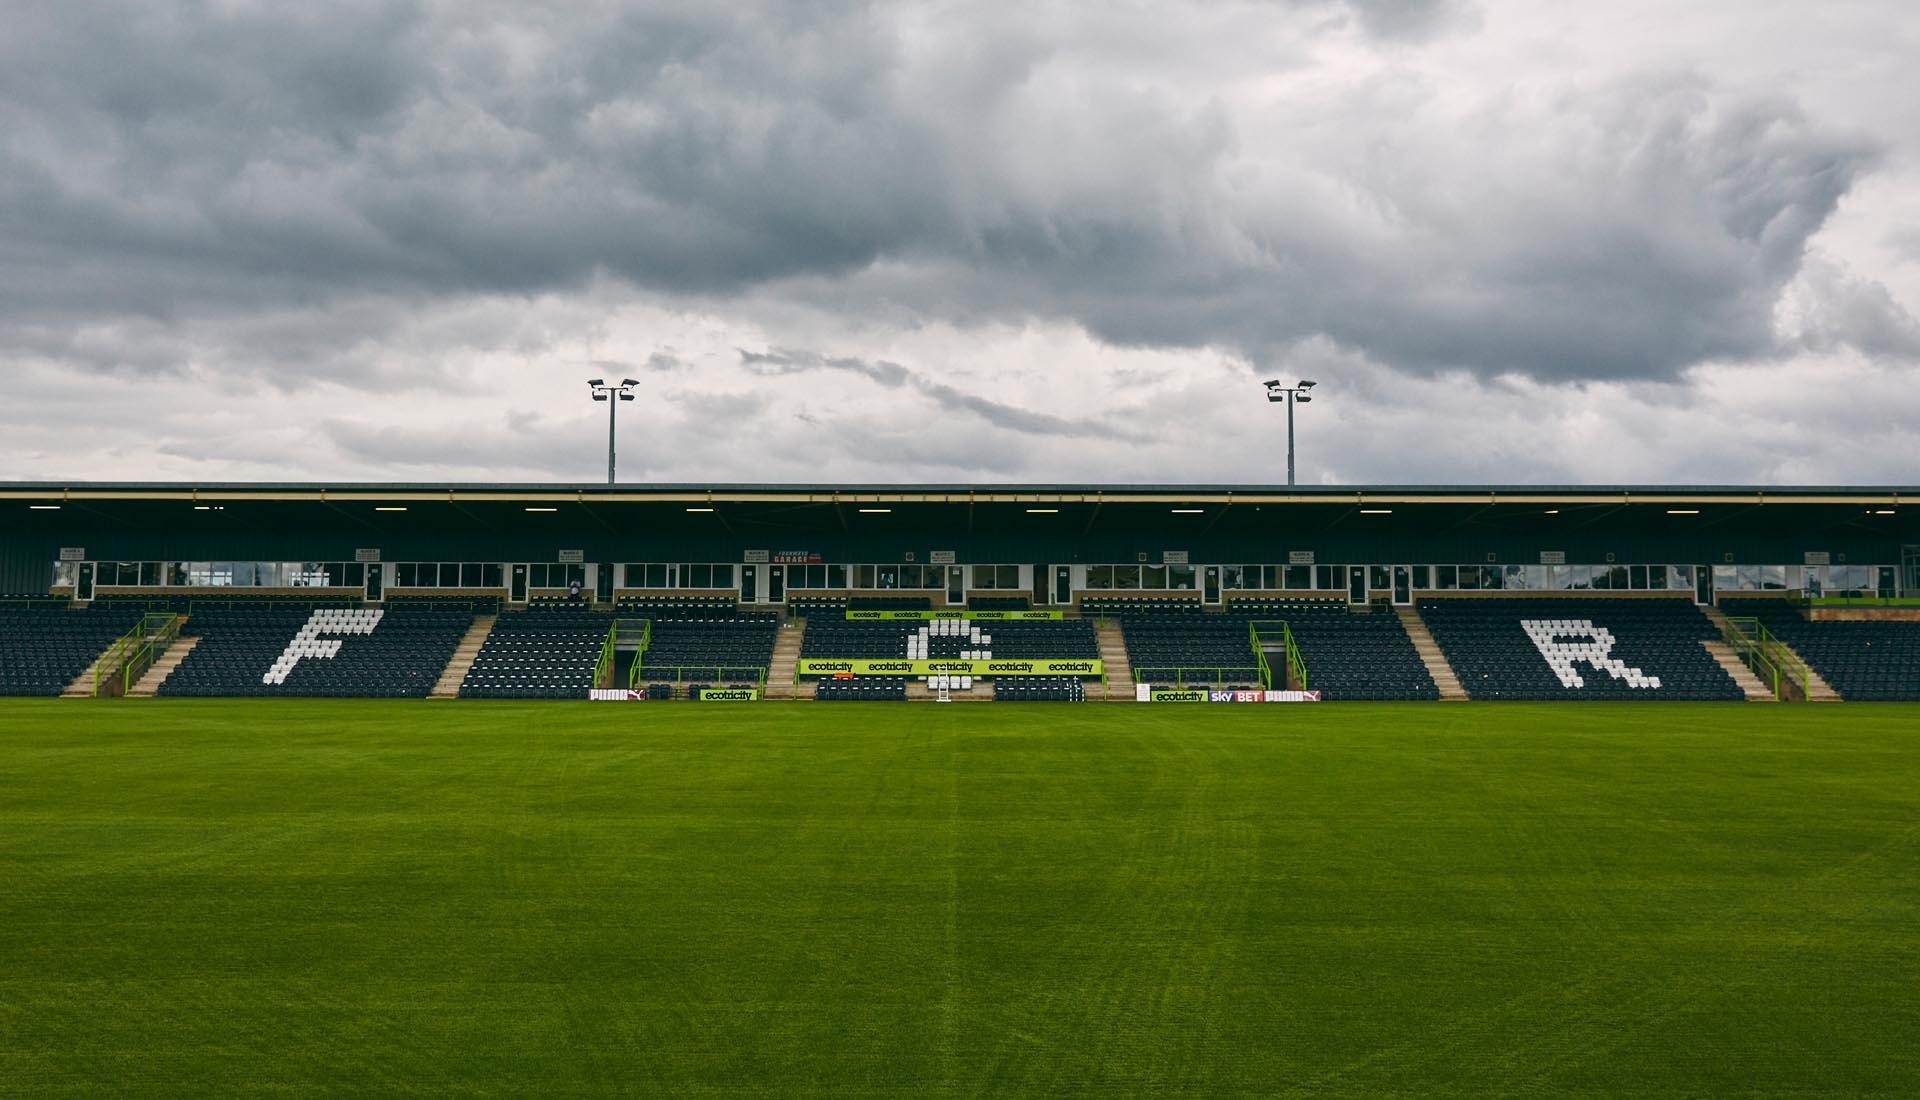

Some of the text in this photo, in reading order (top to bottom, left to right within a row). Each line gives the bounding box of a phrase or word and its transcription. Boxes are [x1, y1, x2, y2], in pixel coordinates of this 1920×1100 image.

[263, 609, 384, 685] F
[1520, 620, 1661, 689] R
[808, 662, 853, 673] ecotricity
[868, 662, 913, 673] ecotricity
[928, 662, 973, 673] ecotricity
[988, 662, 1033, 673] ecotricity
[1048, 662, 1093, 673] ecotricity
[705, 690, 752, 701] ecotricity
[1156, 691, 1203, 702] ecotricity
[1211, 691, 1260, 702] sky BET
